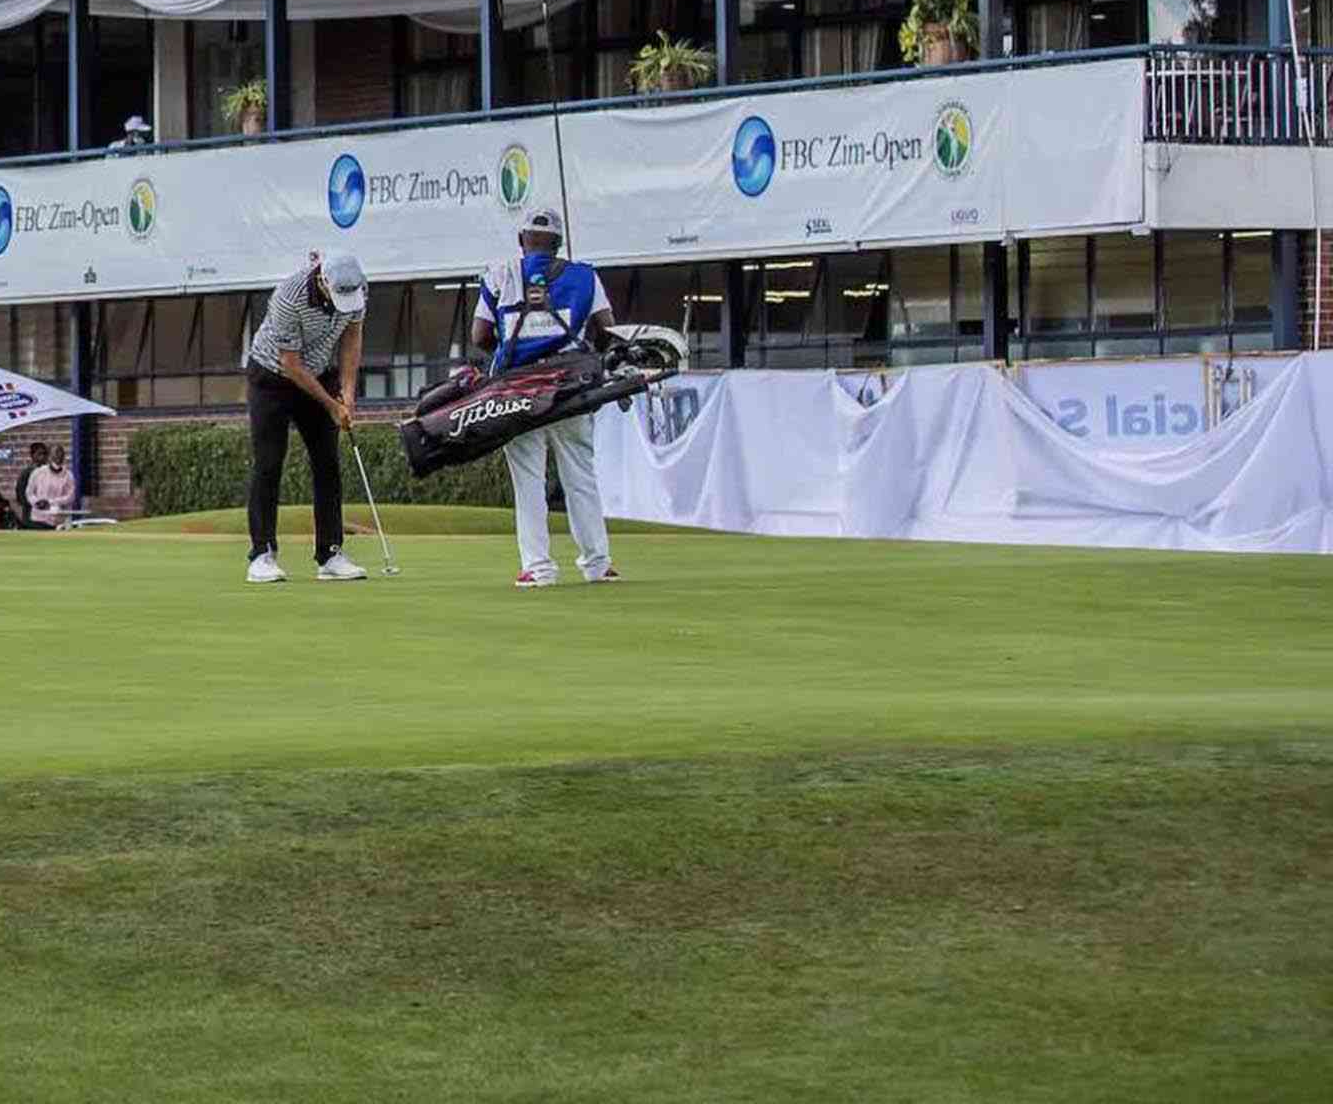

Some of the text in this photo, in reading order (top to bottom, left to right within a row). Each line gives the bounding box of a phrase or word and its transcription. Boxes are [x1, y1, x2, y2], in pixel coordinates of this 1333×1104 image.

[780, 131, 922, 171] FBC Zim-Open
[368, 168, 490, 206] FBC Zim-Open
[15, 199, 120, 234] FBC Zim-Open
[449, 398, 532, 437] Titleist
